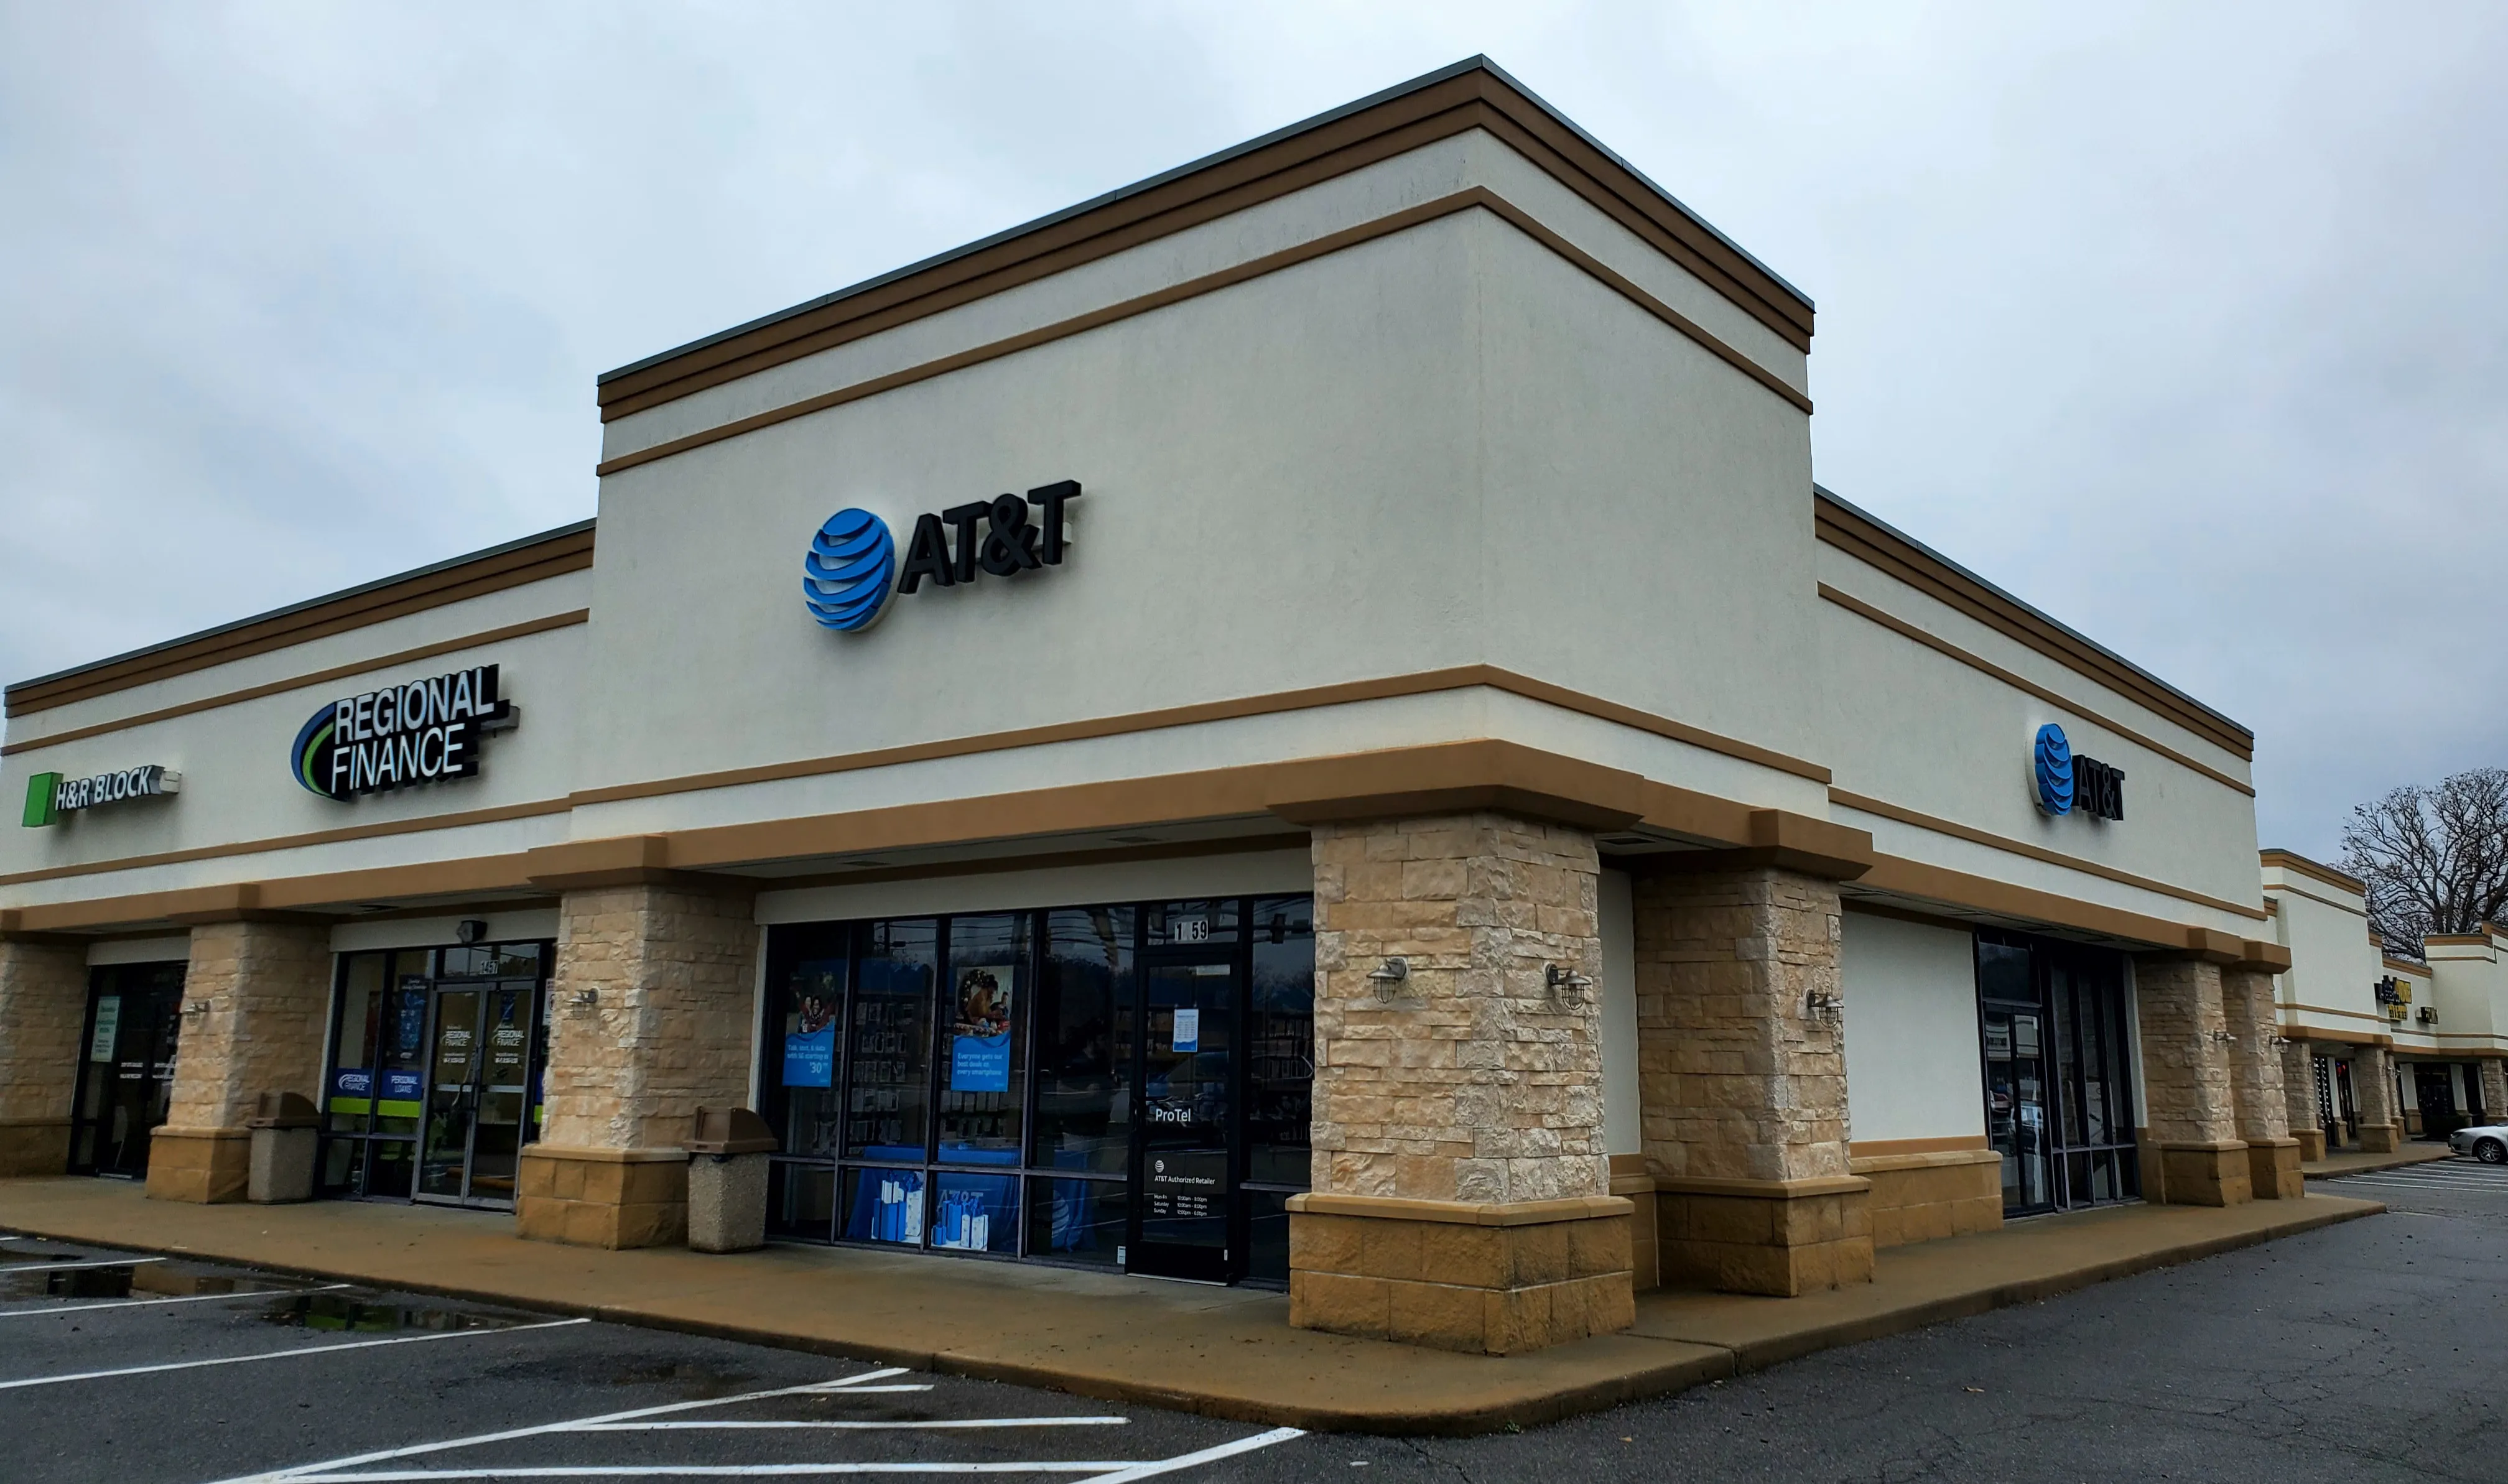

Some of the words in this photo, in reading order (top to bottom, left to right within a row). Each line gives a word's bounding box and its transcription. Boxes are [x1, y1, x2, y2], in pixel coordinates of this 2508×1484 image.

[897, 480, 1081, 594] AT&T
[334, 667, 495, 745] REGIONAL
[331, 722, 465, 794] FINANCE
[55, 777, 91, 811] H&R
[93, 766, 153, 805] BLOCK
[2073, 754, 2125, 821] AT&T
[391, 1075, 419, 1085] PERSONAL
[394, 1084, 413, 1093] LOANS
[1155, 1107, 1191, 1122] ProTel
[1168, 1175, 1195, 1184] Authorized
[1196, 1177, 1215, 1185] Retailer
